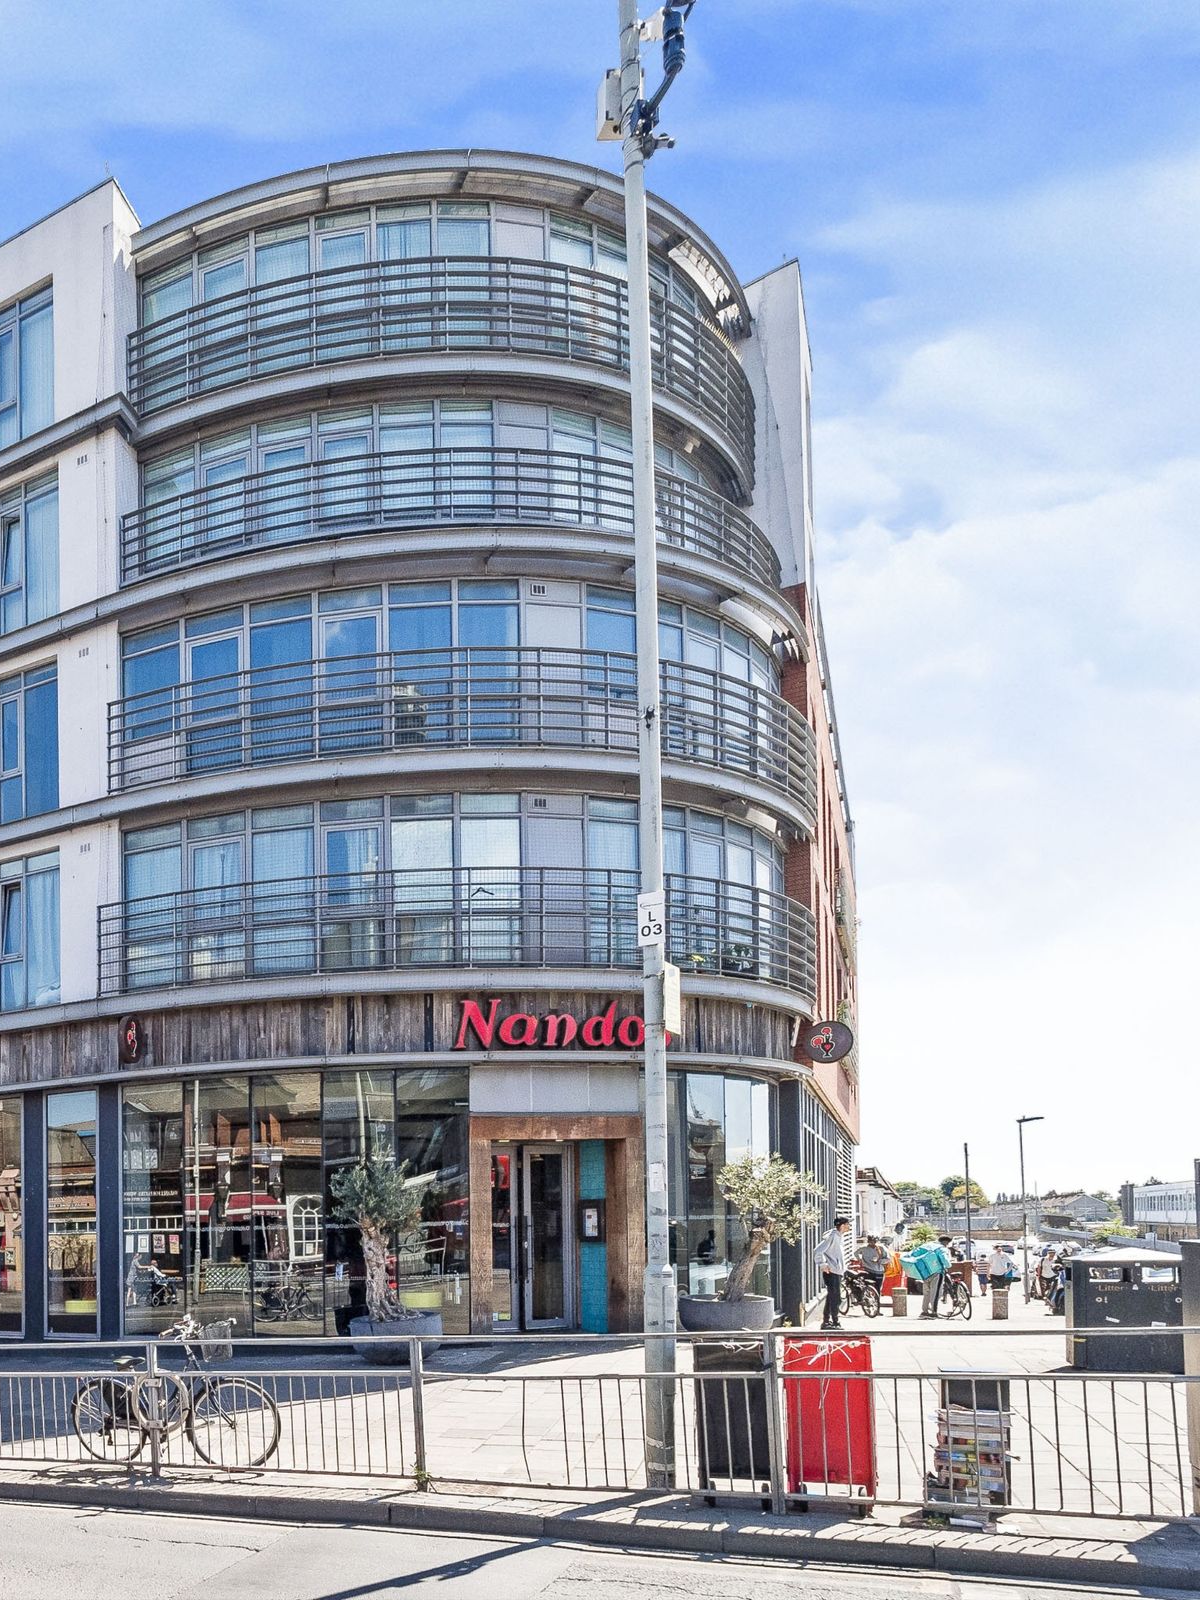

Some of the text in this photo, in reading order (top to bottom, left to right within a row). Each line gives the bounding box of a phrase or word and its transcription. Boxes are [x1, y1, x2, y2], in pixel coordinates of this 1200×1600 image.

[648, 911, 657, 922] L
[641, 923, 663, 937] 03
[1098, 1284, 1124, 1292] Litter
[1151, 1284, 1178, 1292] Litter
